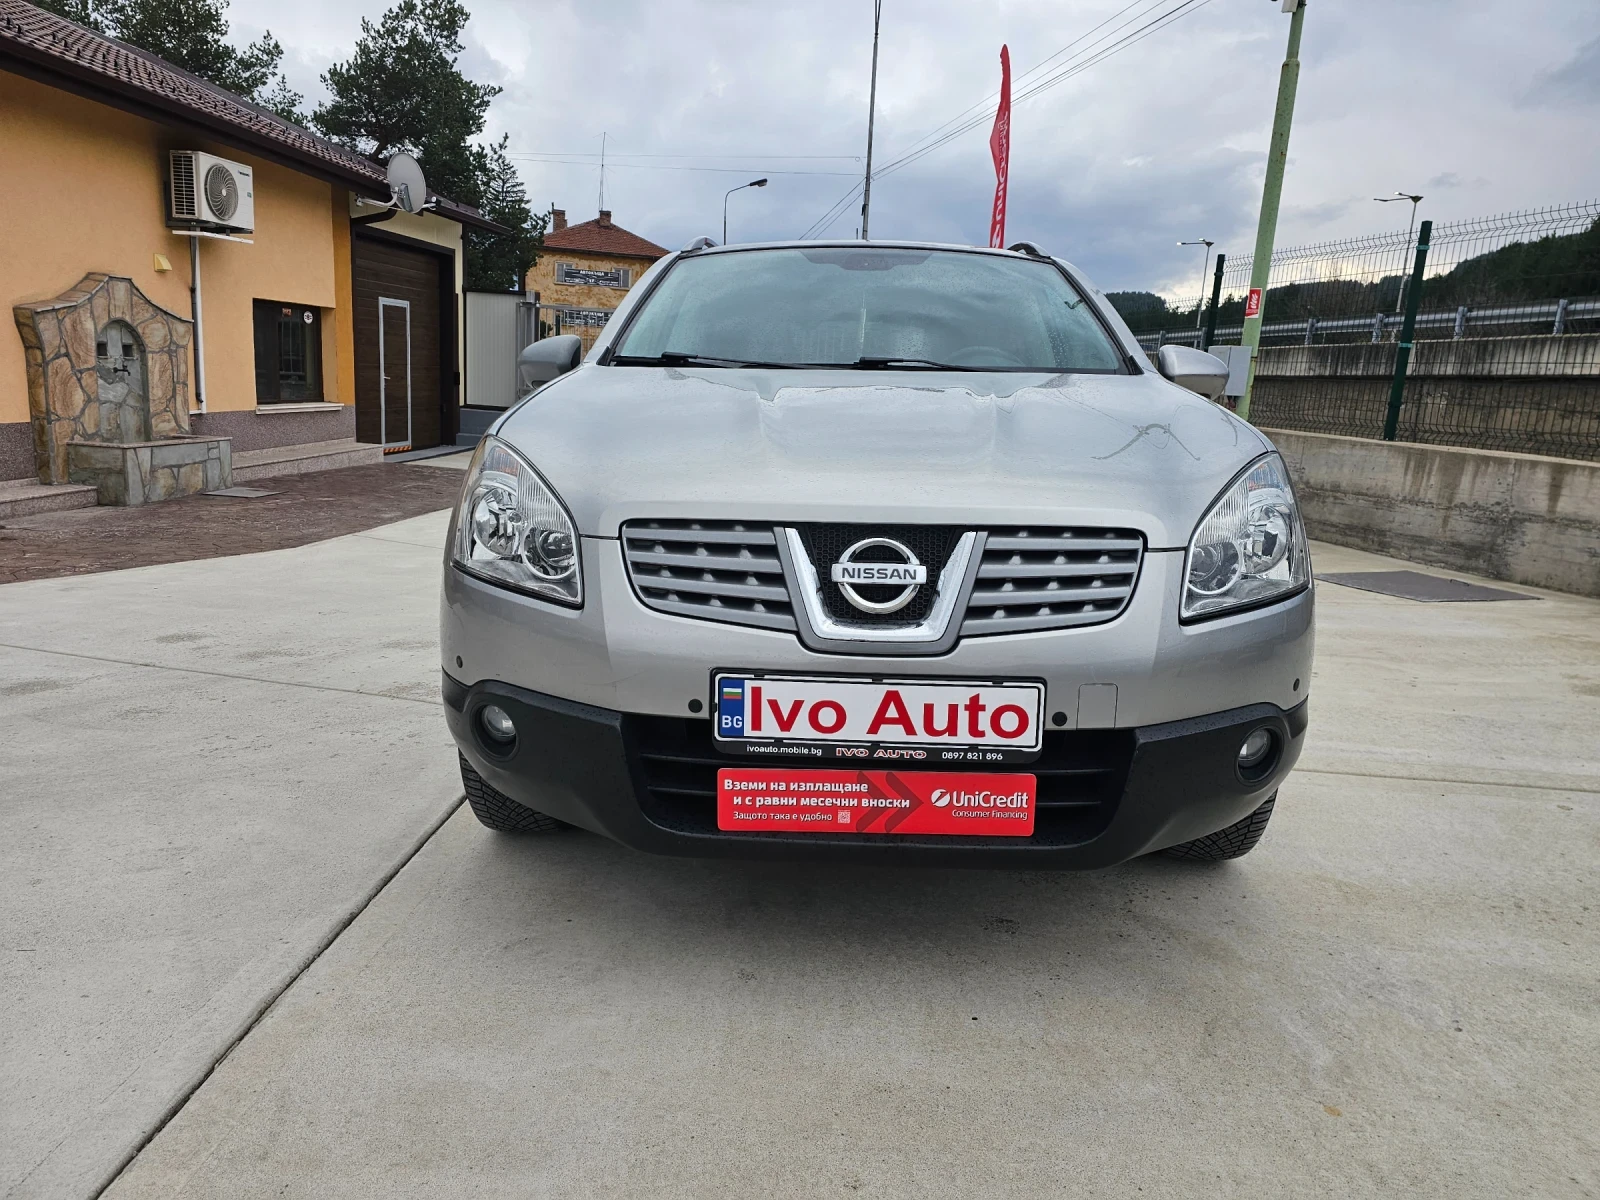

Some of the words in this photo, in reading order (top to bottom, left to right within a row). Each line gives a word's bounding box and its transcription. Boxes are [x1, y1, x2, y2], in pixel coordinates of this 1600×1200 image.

[842, 567, 917, 580] NISSAN
[751, 686, 847, 734] Ivo
[866, 689, 1030, 739] Auto
[721, 715, 743, 728] BG
[746, 744, 822, 756] ivoauto.mobile.bg
[835, 747, 869, 757] IVO
[873, 749, 927, 759] AUTO
[941, 752, 964, 760] 0897
[985, 753, 1003, 761] 896
[724, 779, 767, 791] Вземи
[770, 781, 787, 791] на
[790, 781, 869, 794] изплащане
[733, 796, 742, 805] и
[745, 796, 753, 805] с
[756, 796, 797, 808] равни
[800, 797, 858, 807] месечни
[861, 798, 910, 808] вноски
[952, 790, 1029, 808] UniCredit
[733, 811, 768, 821] Защото
[769, 813, 790, 821] така
[799, 811, 833, 822] удобно
[952, 809, 990, 818] Consumer
[991, 810, 1028, 820] Financing
